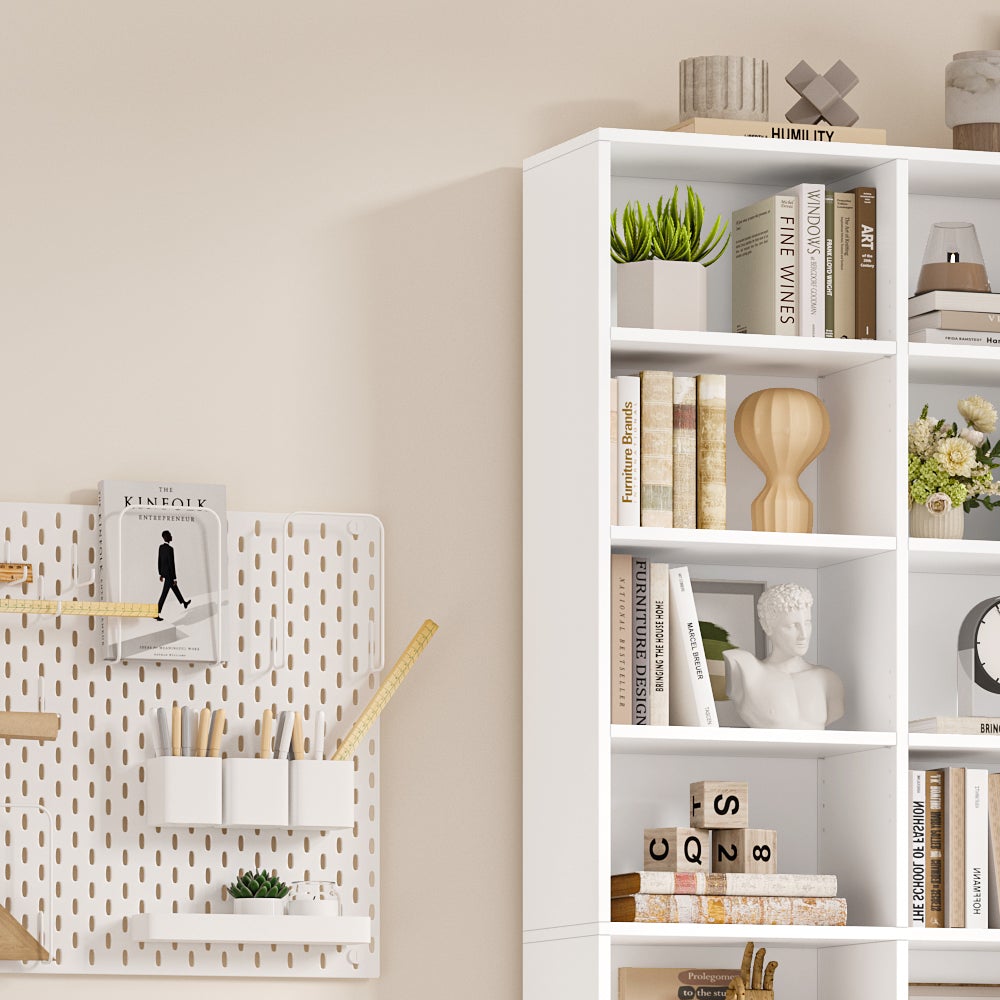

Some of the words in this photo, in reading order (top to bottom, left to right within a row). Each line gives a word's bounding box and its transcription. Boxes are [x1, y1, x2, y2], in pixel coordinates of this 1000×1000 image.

[771, 127, 834, 142] HUMILITY
[780, 216, 795, 256] FINE
[807, 190, 821, 255] WINDOWS
[861, 224, 874, 251] ART
[780, 265, 795, 324] WINES
[621, 401, 633, 445] Brands
[621, 448, 633, 503] Furniture
[124, 496, 208, 512] KINFOLK
[138, 514, 195, 522] ENTREPRENEUR
[635, 561, 647, 660] FURNITURE
[655, 600, 664, 619] HOME
[655, 621, 664, 643] HOUSE
[687, 622, 698, 650] MARCEL
[655, 644, 664, 658] THE
[692, 650, 704, 680] BREUER
[655, 659, 664, 692] BRINGING
[635, 665, 647, 725] DESIGN
[683, 836, 702, 865] Q
[752, 844, 771, 863] 8
[683, 989, 694, 997] to
[697, 988, 711, 997] the
